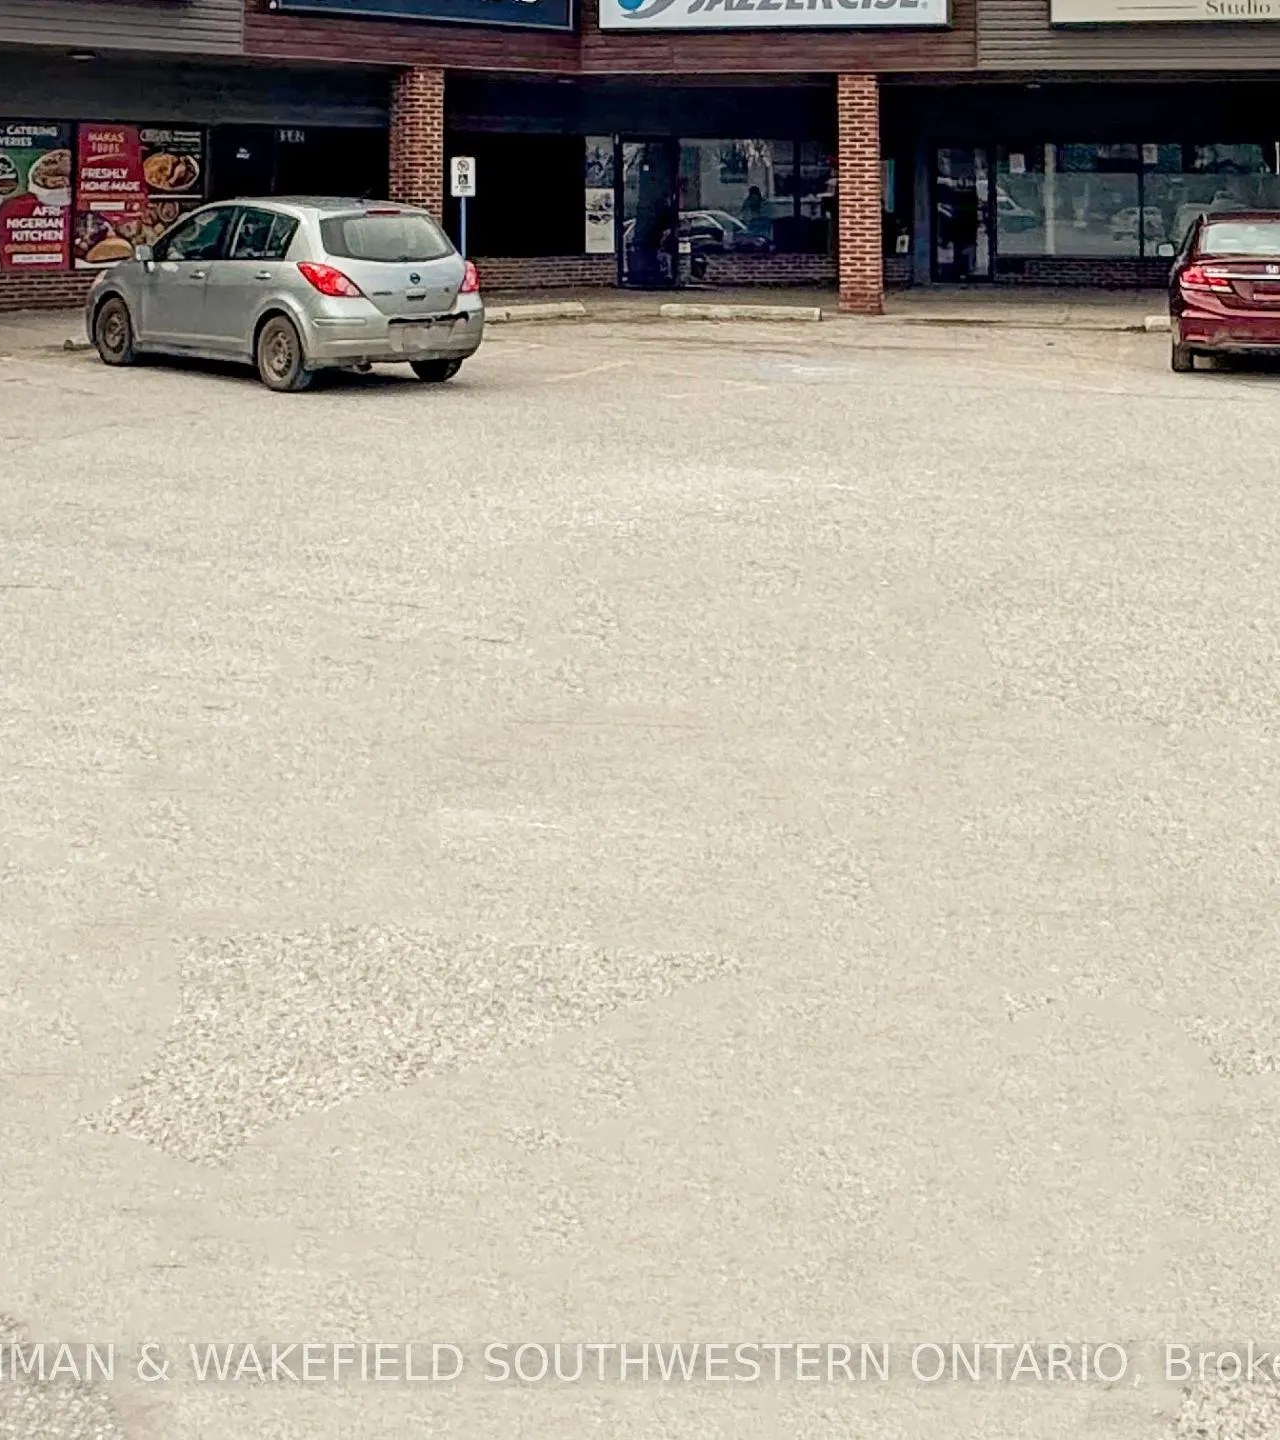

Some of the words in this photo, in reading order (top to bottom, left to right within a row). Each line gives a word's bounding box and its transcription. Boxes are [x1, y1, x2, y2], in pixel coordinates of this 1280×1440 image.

[1204, 0, 1271, 16] Studio
[6, 125, 58, 137] CATERING
[81, 167, 129, 179] FRESHLY
[6, 217, 65, 229] NIGERIAN
[11, 229, 65, 241] KITCHEN
